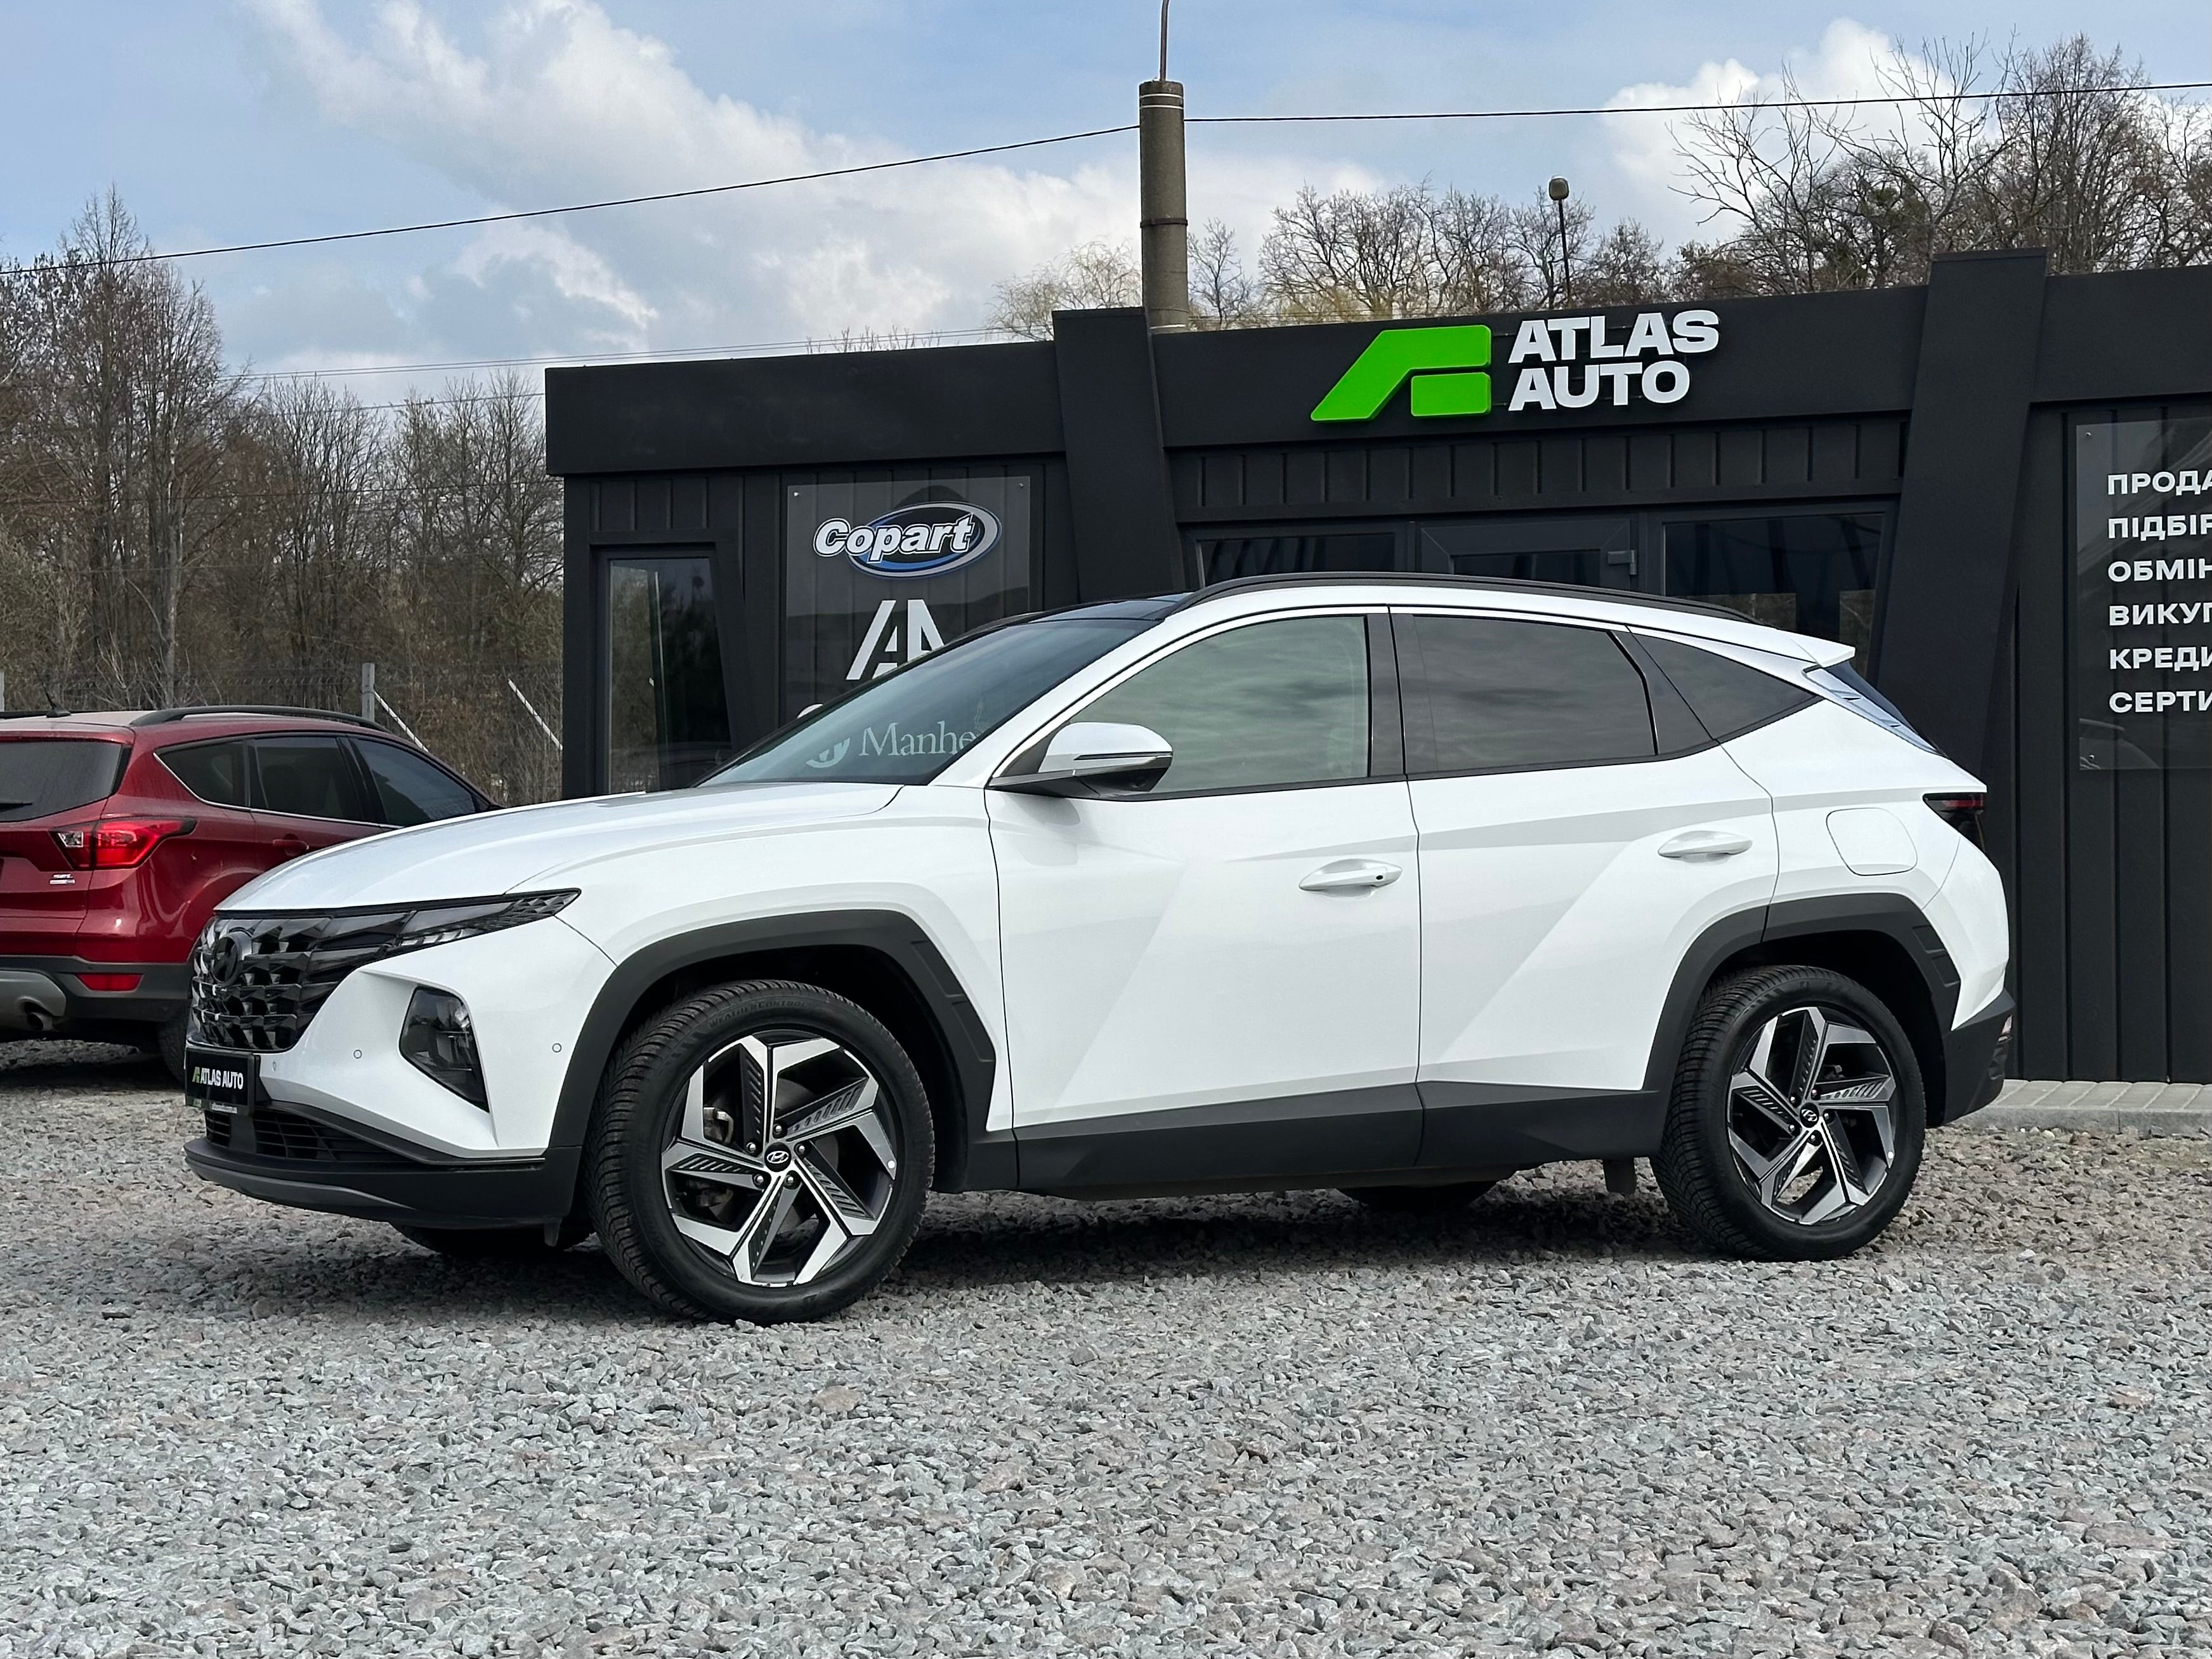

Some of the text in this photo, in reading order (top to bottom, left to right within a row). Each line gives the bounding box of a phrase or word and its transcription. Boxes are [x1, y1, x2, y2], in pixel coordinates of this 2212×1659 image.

[1508, 310, 1720, 364] ATLAS
[1508, 360, 1690, 412] AUTO
[813, 513, 976, 564] Copart
[858, 721, 977, 756] Manhe
[200, 1067, 244, 1090] ATLAS AUTO
